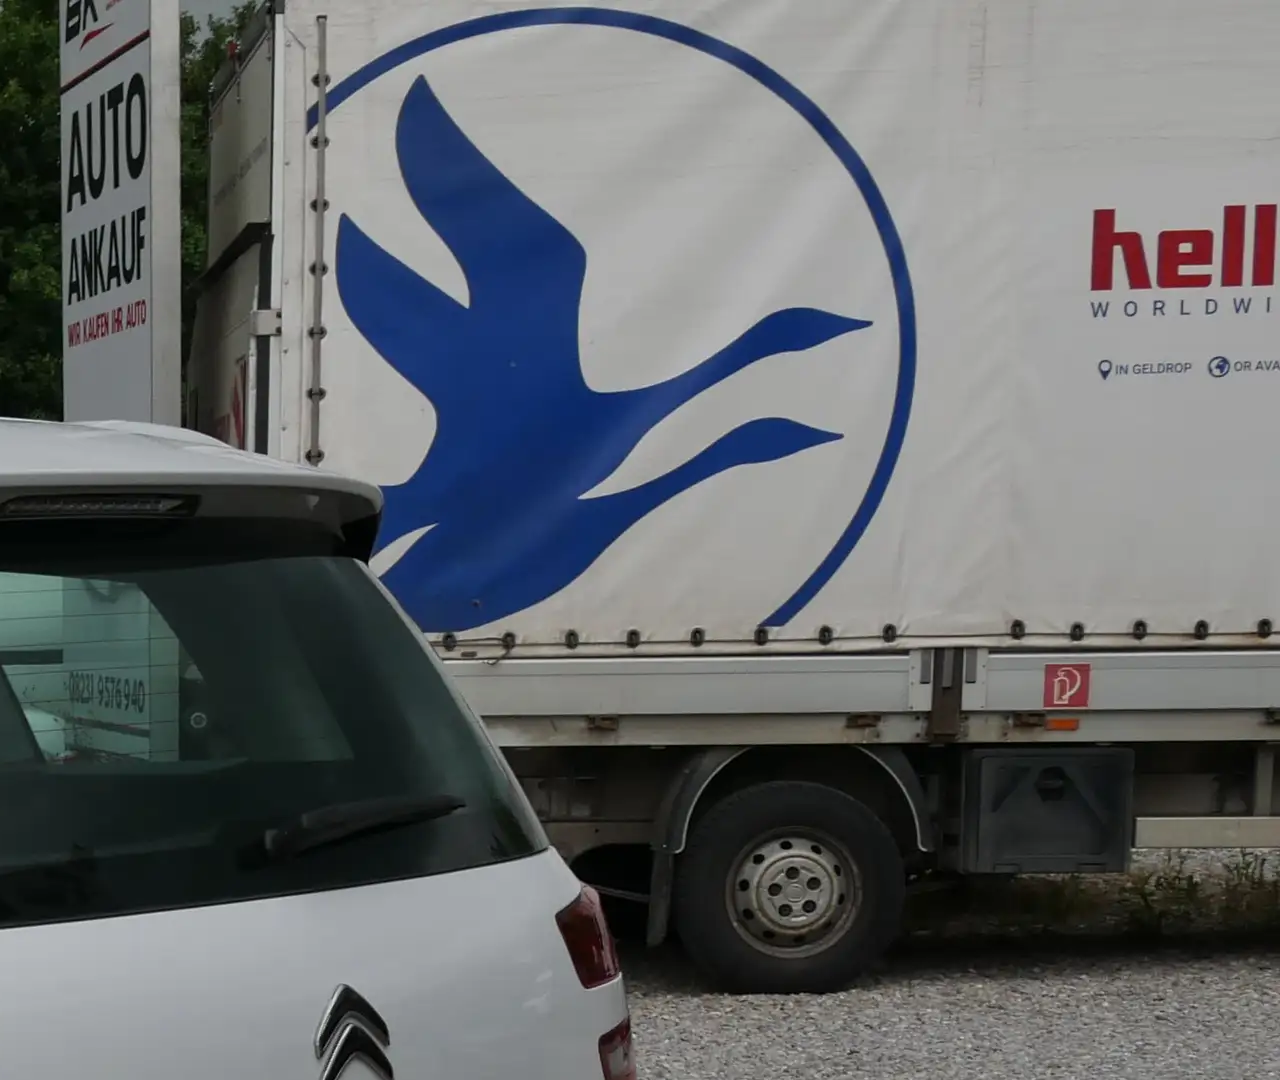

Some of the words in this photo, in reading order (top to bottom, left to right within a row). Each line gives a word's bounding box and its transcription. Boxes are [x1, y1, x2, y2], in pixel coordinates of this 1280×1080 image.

[66, 72, 147, 214] AUTO
[67, 206, 146, 306] ANKAUF
[1091, 203, 1278, 291] hell
[68, 321, 81, 348] WIR
[83, 311, 109, 344] KAUFEN
[112, 306, 123, 334] IHR
[125, 299, 147, 330] AUTO
[1091, 297, 1272, 318] WORLDWI
[1115, 364, 1128, 375] IN
[1132, 362, 1192, 375] GELDROP
[1233, 361, 1253, 372] OR
